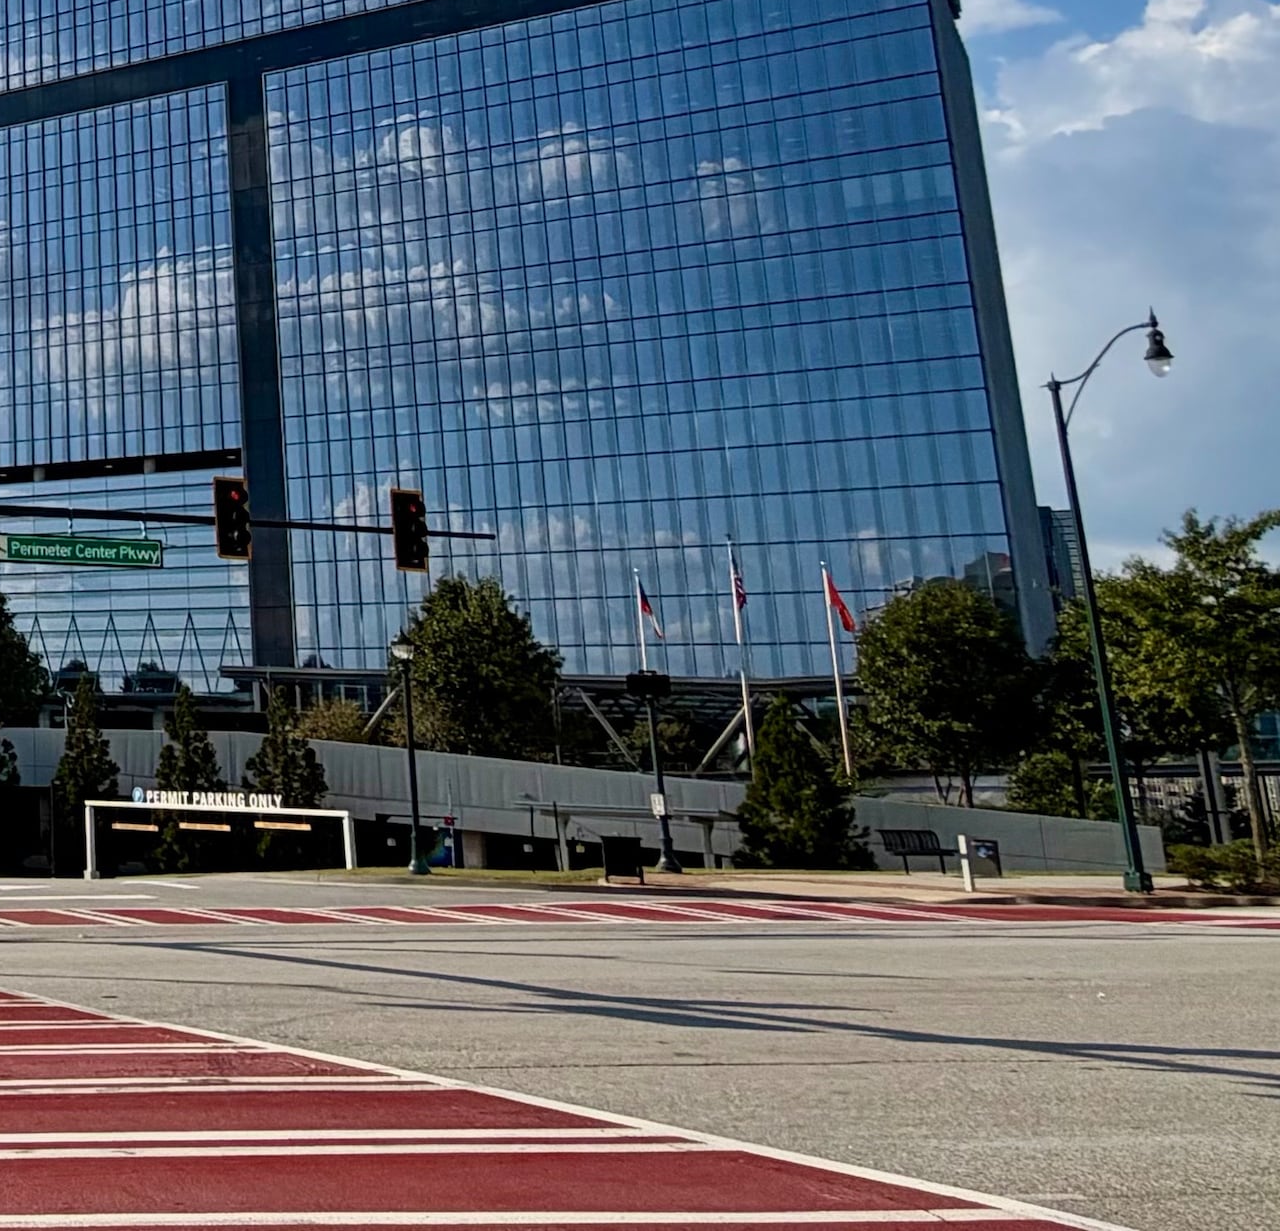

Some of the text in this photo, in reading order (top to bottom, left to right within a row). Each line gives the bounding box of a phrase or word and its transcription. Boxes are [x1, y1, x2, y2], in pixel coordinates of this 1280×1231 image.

[11, 541, 159, 564] Perimeter Center Pkwy
[146, 790, 189, 805] PERMIT
[192, 792, 246, 807] PARKING
[249, 794, 282, 809] ONLY
